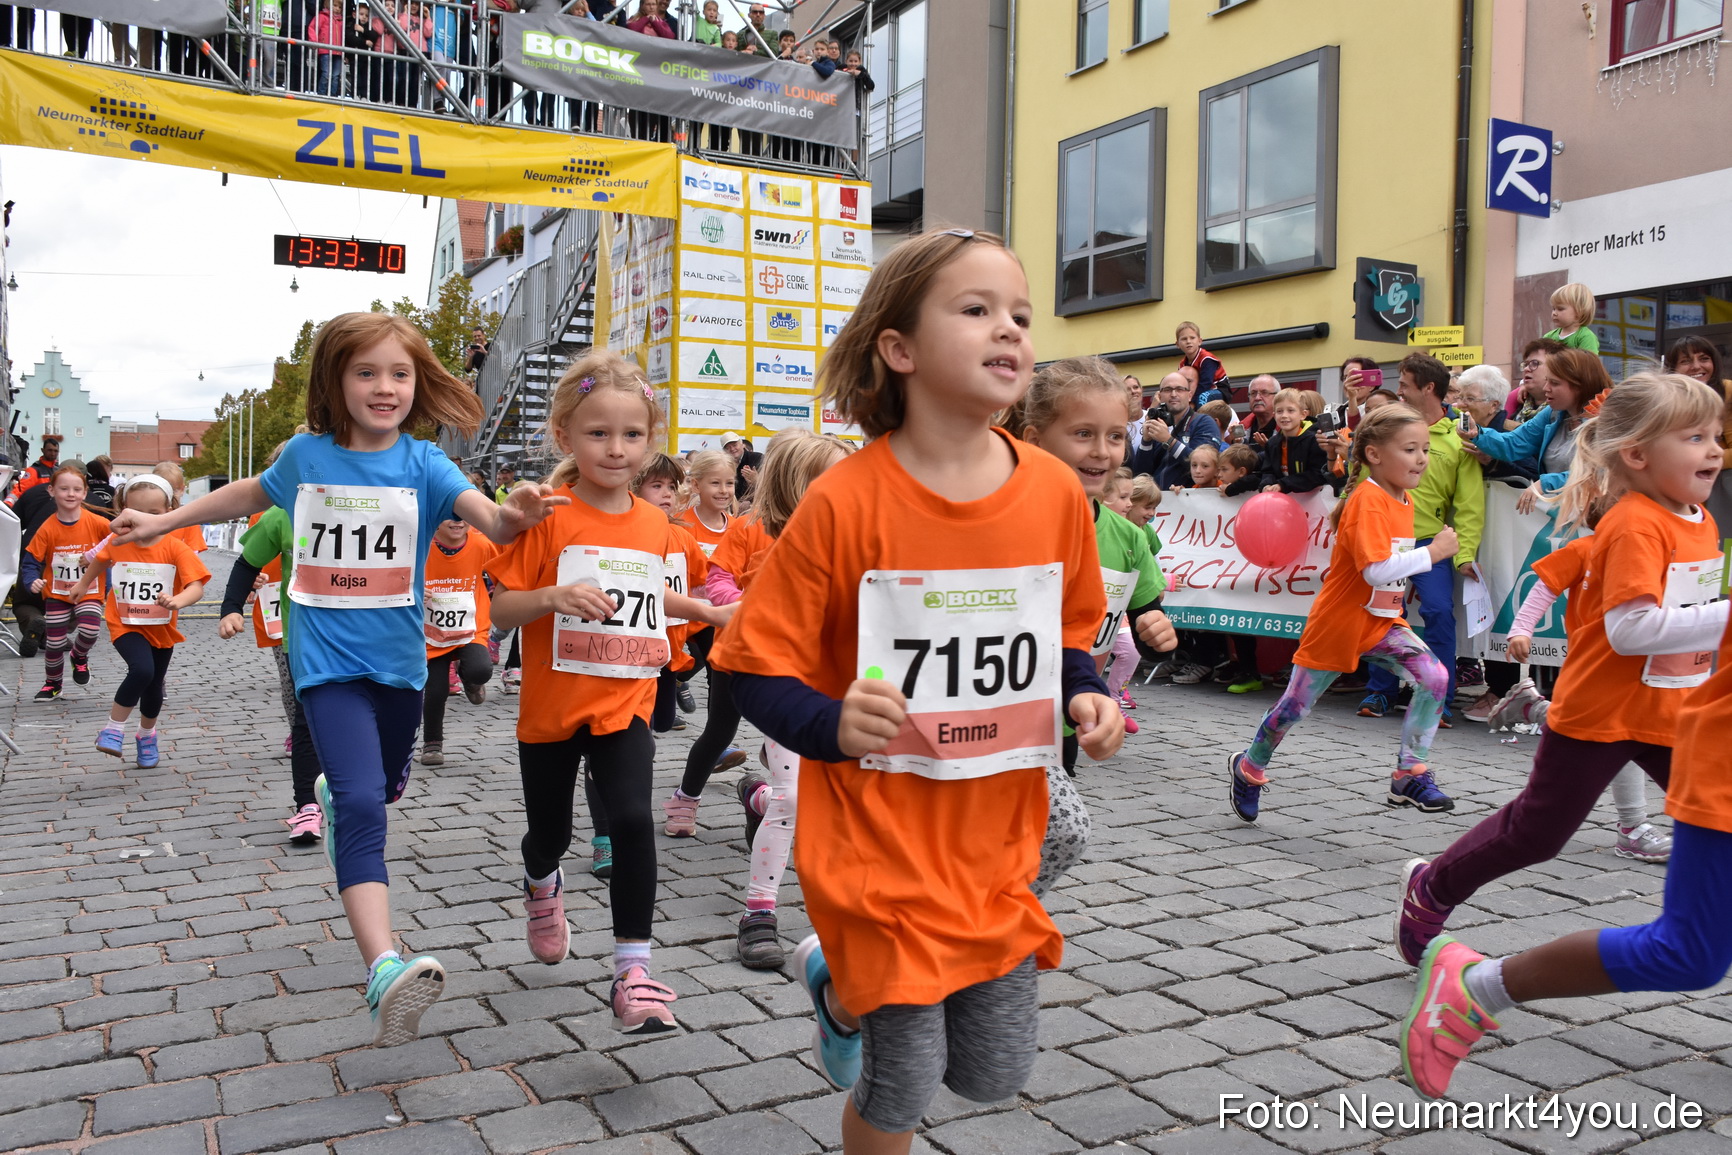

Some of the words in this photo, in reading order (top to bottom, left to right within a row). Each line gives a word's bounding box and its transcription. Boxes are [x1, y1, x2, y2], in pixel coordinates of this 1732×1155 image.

[523, 31, 641, 76] BOCK
[522, 57, 559, 71] inspired
[562, 64, 573, 74] by
[576, 67, 602, 79] smart
[604, 72, 645, 86] concepts
[660, 61, 709, 82] OFFICE
[713, 72, 780, 94] INDUSTRY
[785, 84, 838, 106] LOUNGE
[691, 86, 814, 119] www.bockonline.de
[37, 106, 132, 132] Neumarkter
[135, 121, 206, 141] Stadtlauf
[295, 119, 446, 178] ZIEL
[523, 169, 591, 187] Neumarkter
[595, 178, 650, 189] Stadtlauf
[714, 193, 740, 201] energie
[754, 229, 791, 244] swn
[1549, 240, 1600, 261] Unterer
[1603, 231, 1644, 251] Markt
[1649, 225, 1666, 243] 15
[683, 271, 725, 282] RAIL.ONE
[786, 274, 806, 283] CODE
[786, 282, 809, 291] CLINIC
[824, 285, 862, 295] RAIL.ONE
[1387, 282, 1408, 315] G2
[699, 315, 743, 327] VARIOTEC
[1417, 329, 1462, 337] Startnummern-
[1441, 352, 1474, 362] Toiletten
[785, 374, 812, 382] energie
[681, 408, 725, 417] RAIL.ONE
[335, 497, 380, 508] BOCK
[311, 522, 397, 561] 7114
[611, 560, 649, 575] BOCK
[119, 581, 164, 601] 7153
[331, 573, 367, 589] Kajsa
[946, 588, 1017, 608] BOCK
[427, 607, 467, 628] 7287
[1165, 611, 1206, 625] ice-Line:
[1264, 618, 1281, 632] 63
[1093, 610, 1122, 649] 01
[587, 635, 651, 664] NORA
[1561, 646, 1568, 657] S
[893, 632, 1037, 700] 7150
[937, 722, 998, 745] Emma
